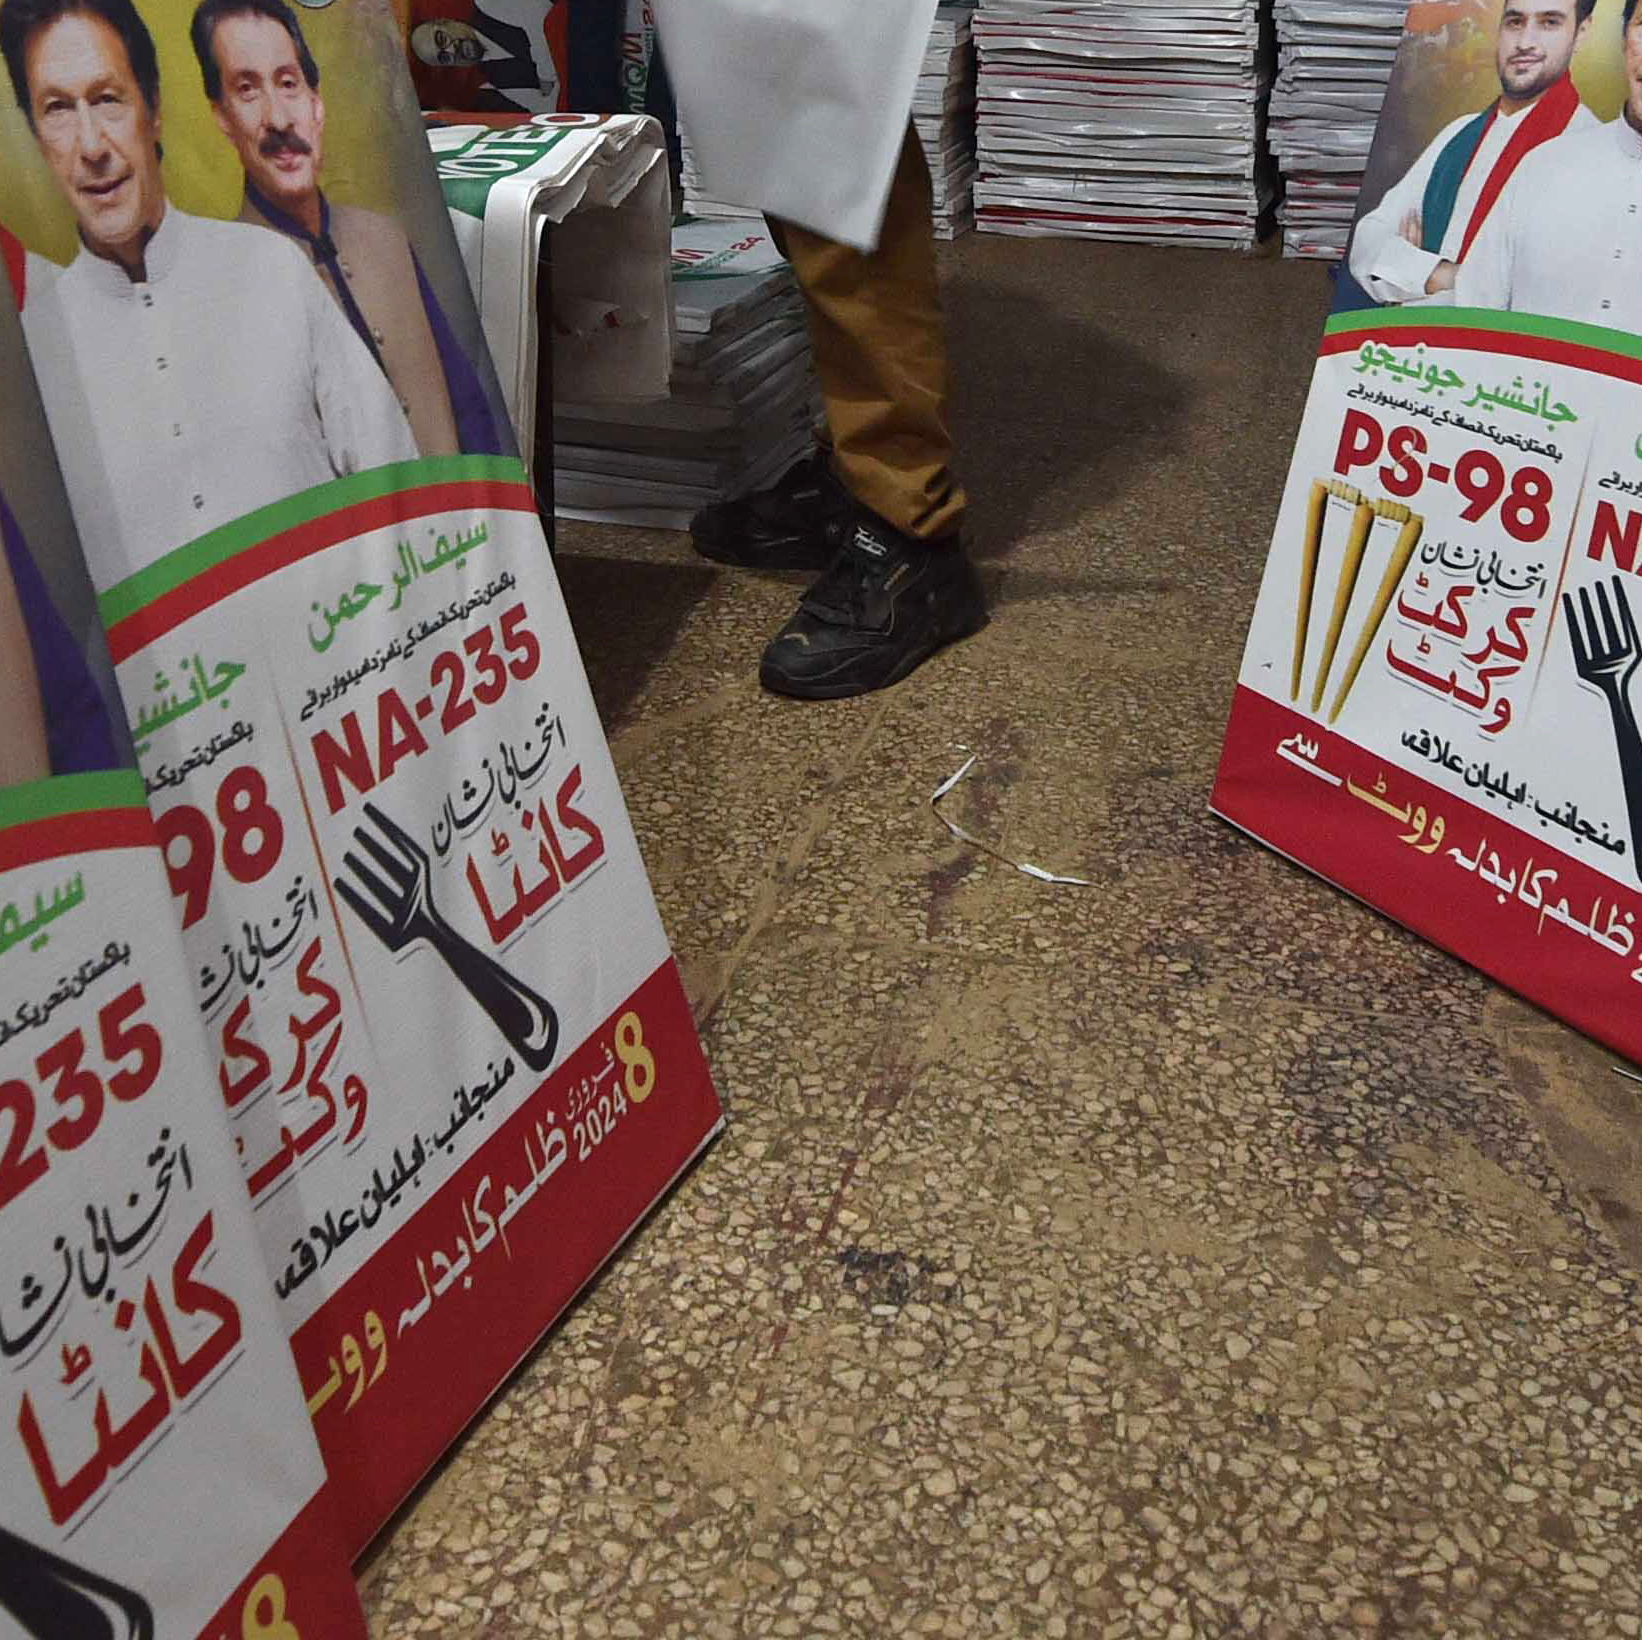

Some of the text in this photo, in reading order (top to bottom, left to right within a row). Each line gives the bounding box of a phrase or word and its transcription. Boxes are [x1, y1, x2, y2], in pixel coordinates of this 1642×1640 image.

[436, 123, 561, 180] VOTE
[1464, 379, 1578, 428] جانشیر
[1335, 409, 1553, 543] PS-98
[1420, 542, 1480, 570] نشان
[312, 603, 541, 814] NA-235
[431, 702, 566, 858] انتخابی نشان
[466, 766, 605, 945] کانٹا
[614, 1011, 656, 1113] 8
[572, 1081, 626, 1162] 2024
